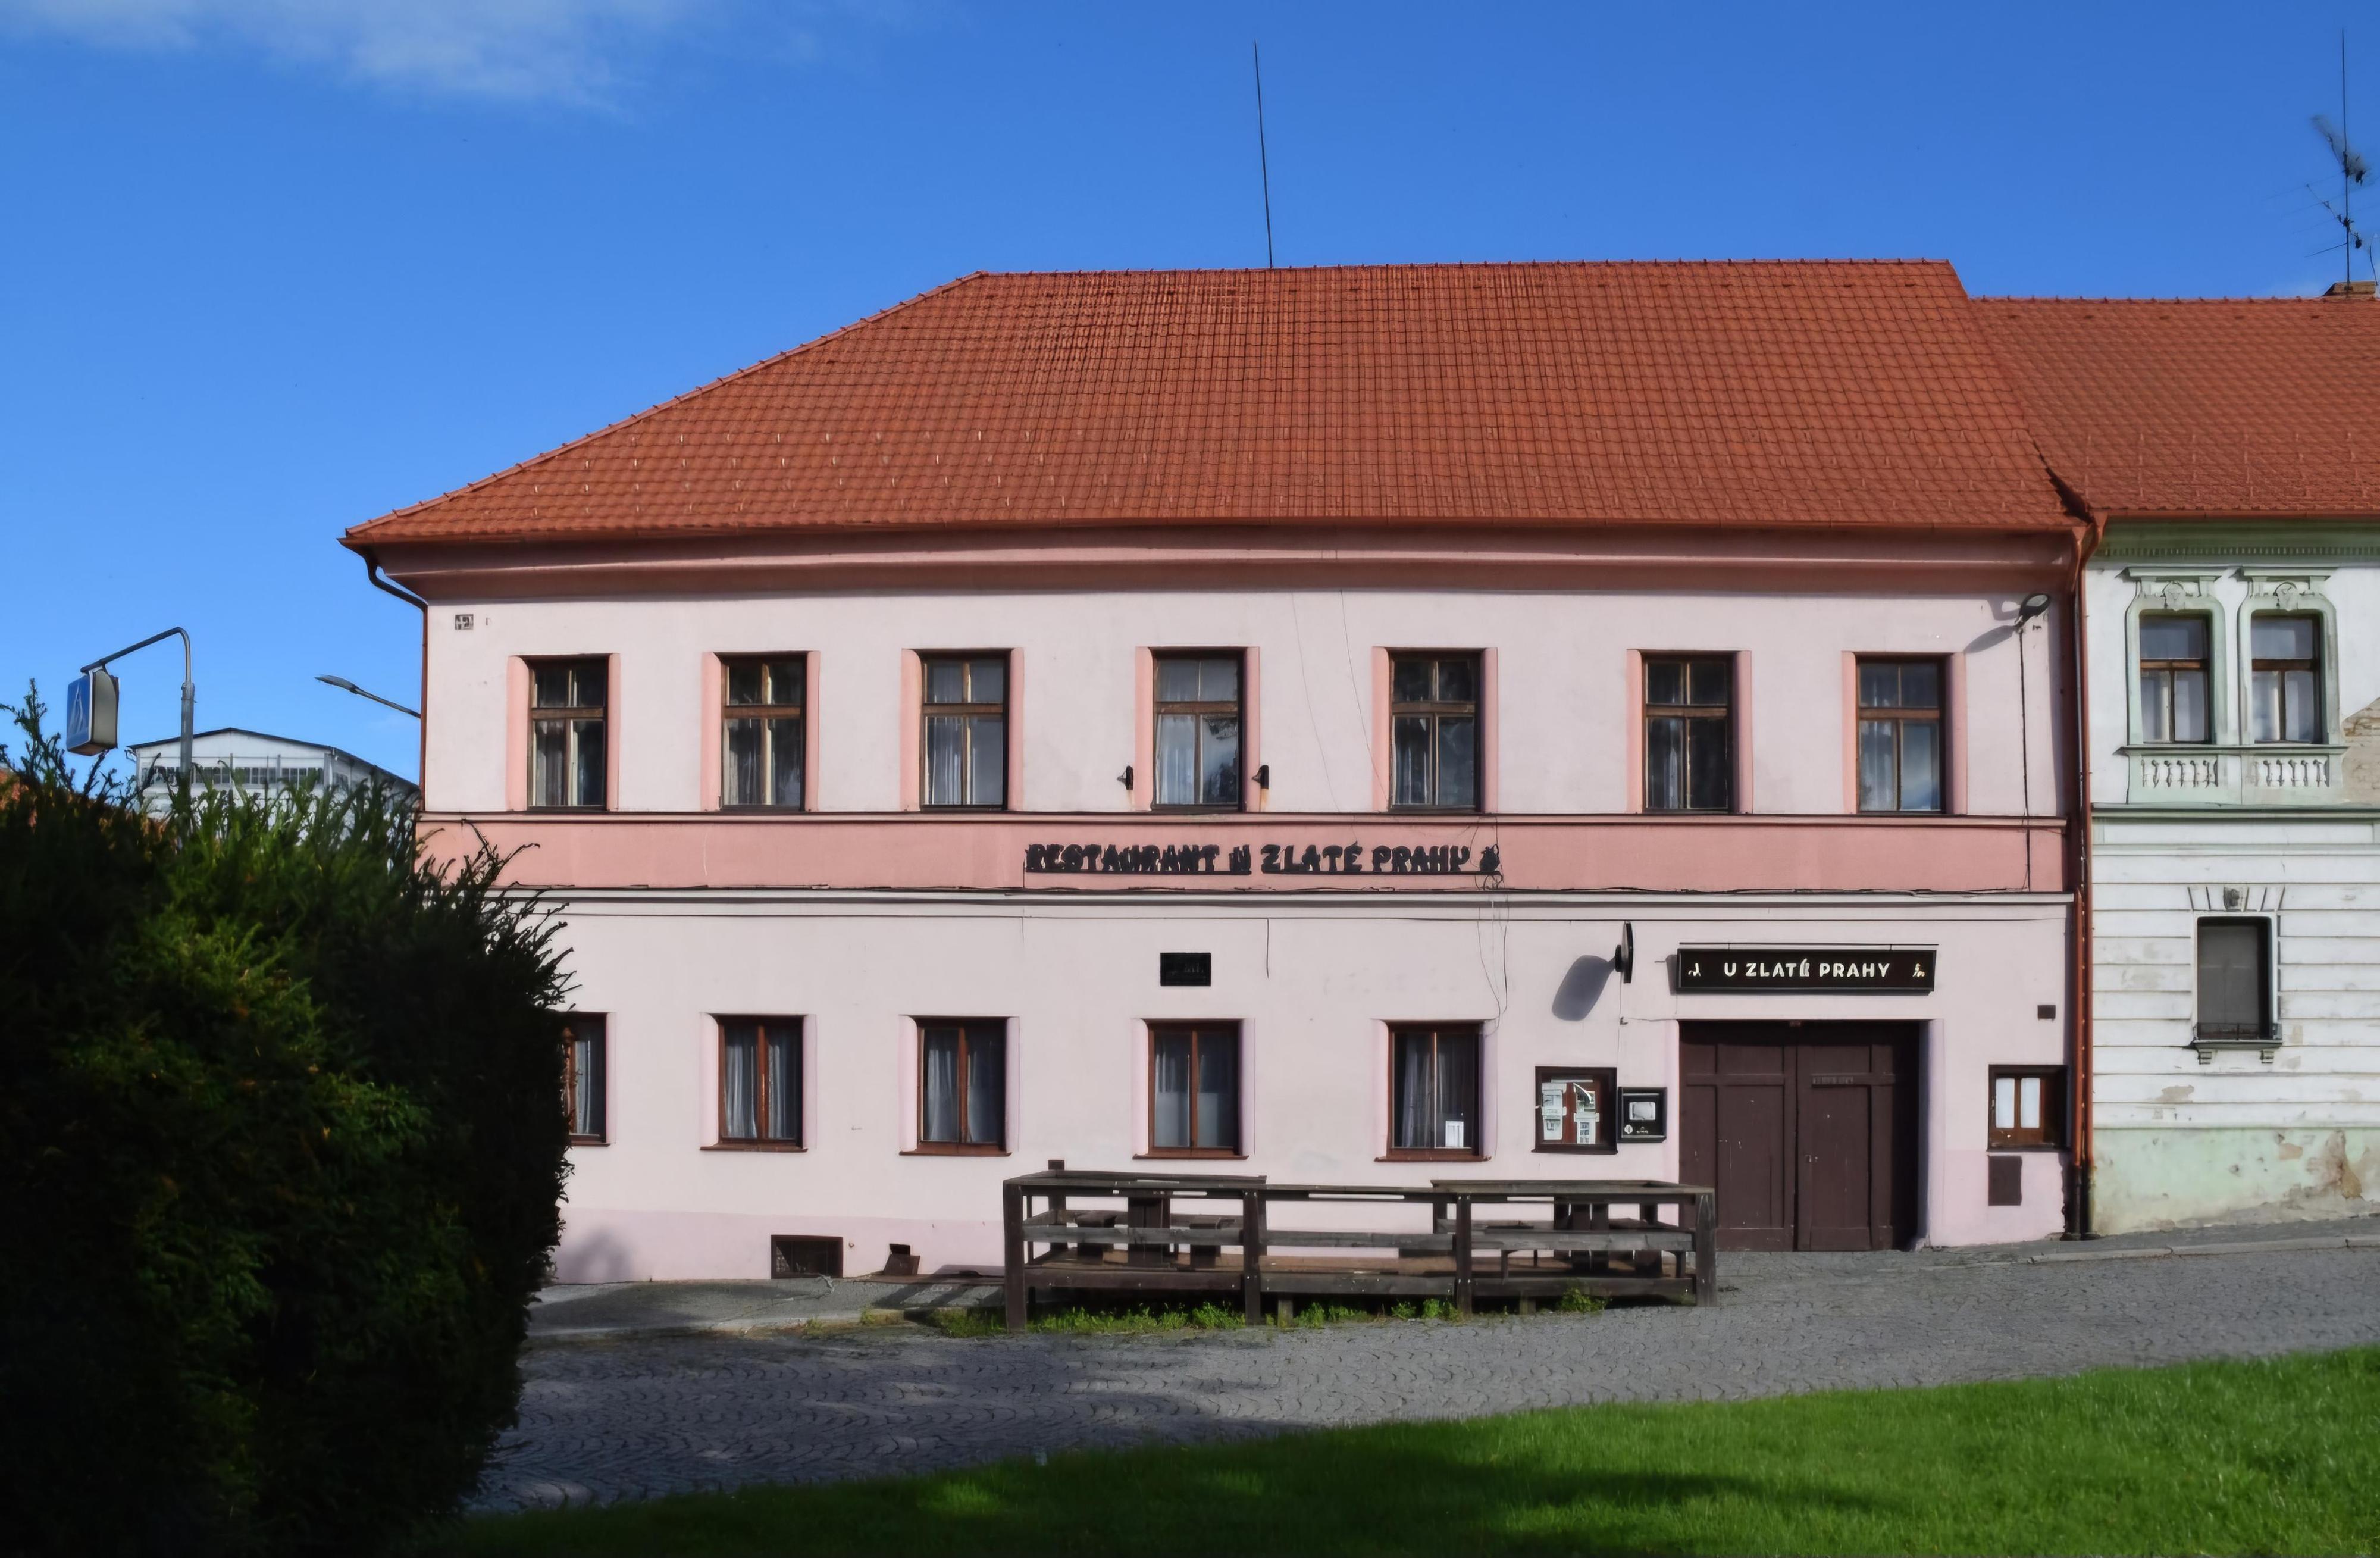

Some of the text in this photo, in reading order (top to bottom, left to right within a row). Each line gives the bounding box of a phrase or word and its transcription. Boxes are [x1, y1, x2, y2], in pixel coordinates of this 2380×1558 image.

[1025, 844, 1220, 872] RESTAURANT
[1260, 840, 1363, 872] ZLATÉ
[1371, 844, 1470, 872] PRAHY
[1724, 958, 1890, 978] U ZLATÉ PRAHY
